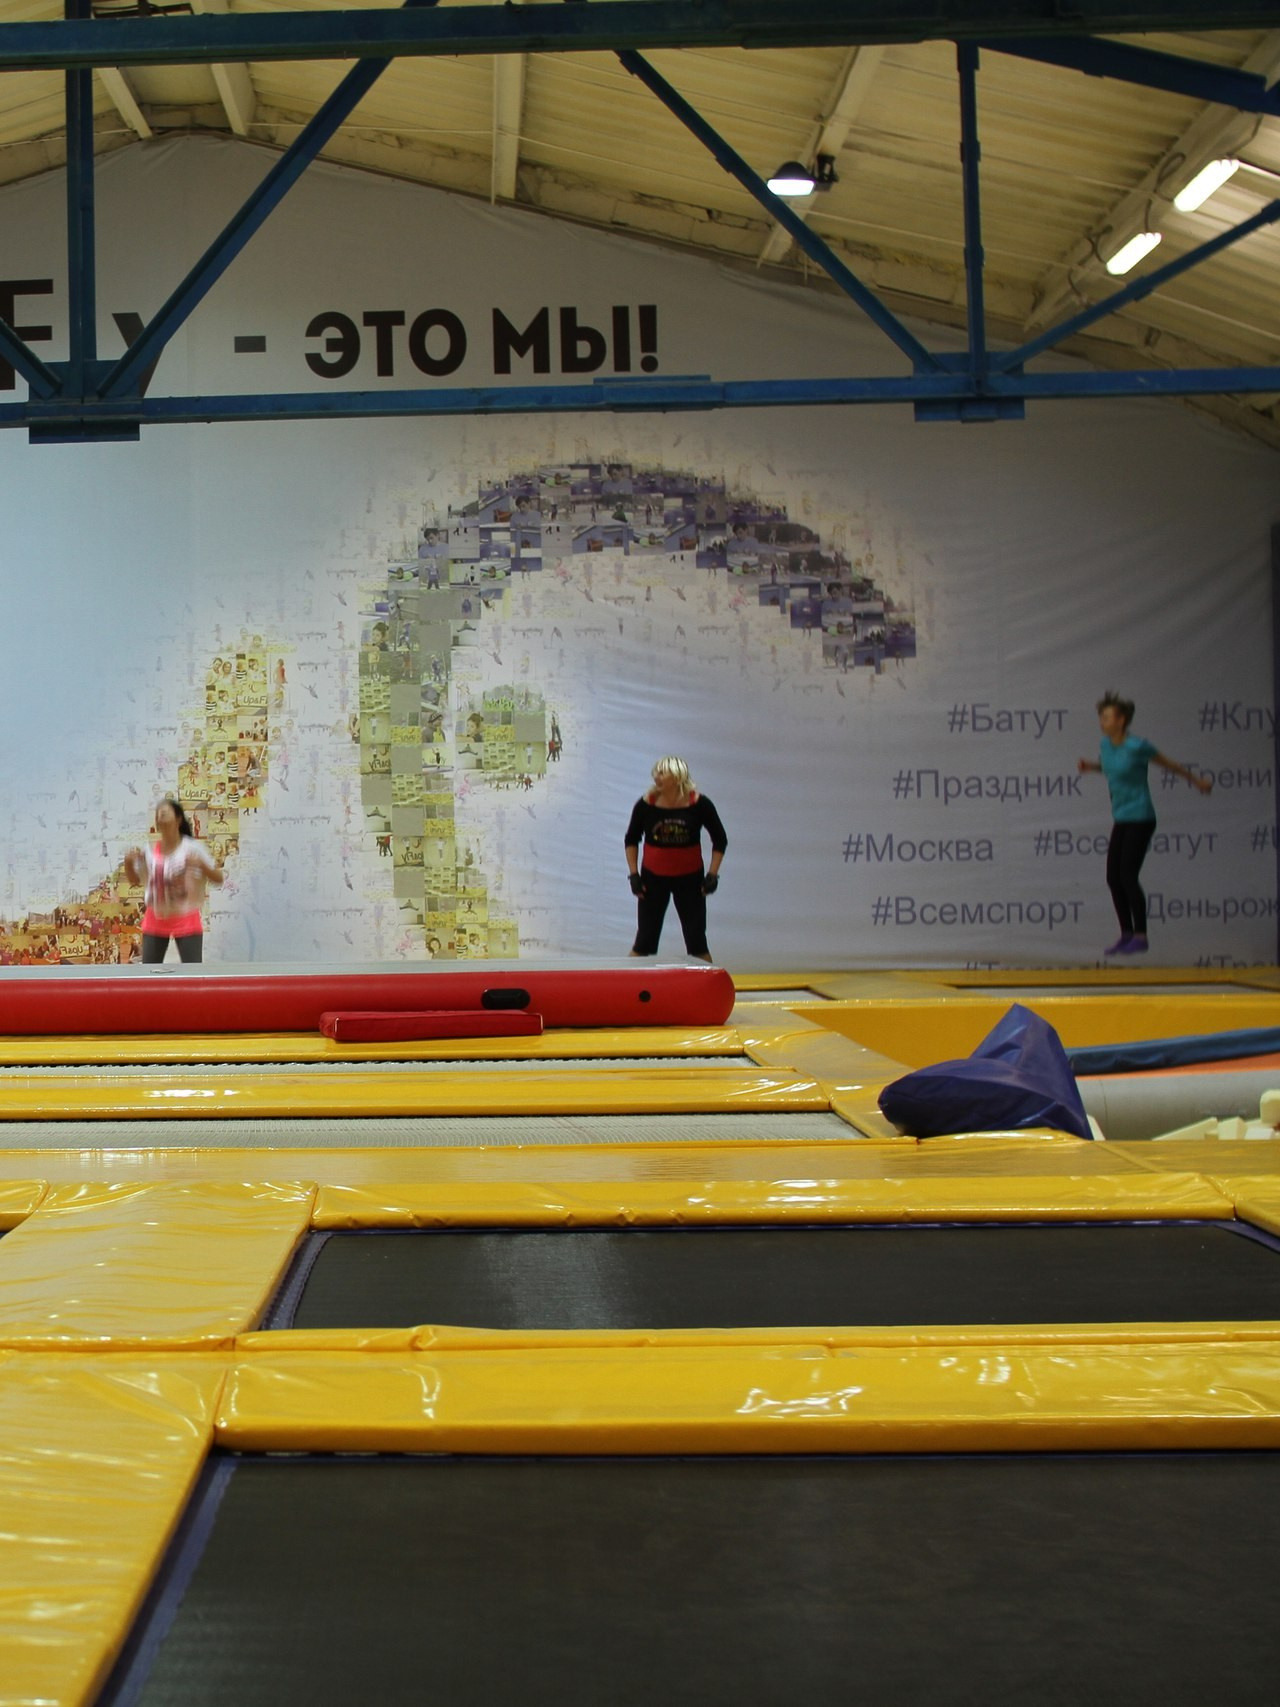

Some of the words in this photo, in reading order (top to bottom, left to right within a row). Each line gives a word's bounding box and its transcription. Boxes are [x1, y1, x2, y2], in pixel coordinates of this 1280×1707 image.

[947, 703, 1069, 740] #Батут
[893, 769, 1083, 805] #Праздник
[842, 833, 994, 863] #Москва
[872, 896, 1084, 930] #Всемспорт
